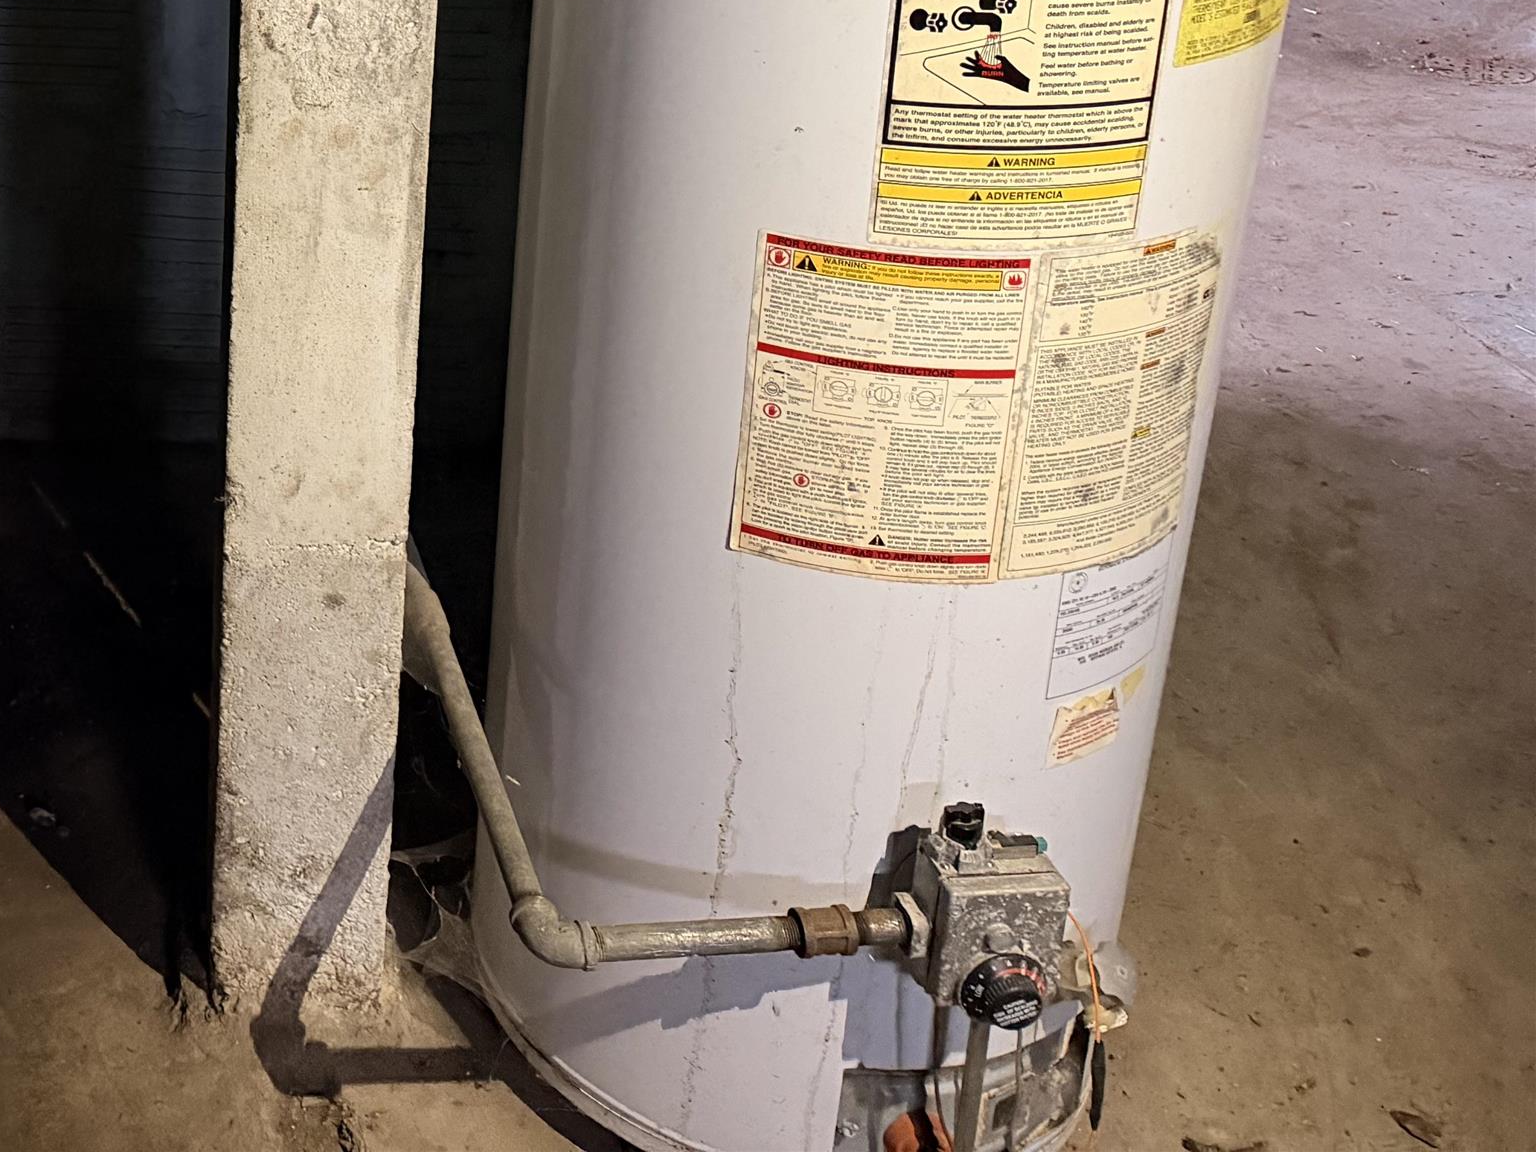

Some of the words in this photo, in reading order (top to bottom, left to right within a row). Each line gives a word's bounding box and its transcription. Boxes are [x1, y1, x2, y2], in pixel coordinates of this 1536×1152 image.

[1003, 158, 1056, 167] WARNING
[986, 191, 1063, 200] ADVERTENCIA
[778, 237, 799, 247] FOR
[805, 241, 833, 254] YOUR
[838, 247, 881, 259] SAFETY
[886, 253, 916, 264] READ
[920, 256, 966, 267] BEFORE
[969, 259, 1020, 268] LIGHTING
[823, 257, 870, 270] WARNING:
[819, 357, 869, 371] LIGHTING
[872, 363, 955, 377] INSTRUCTIONS
[779, 534, 790, 543] TO
[793, 536, 823, 548] TURN
[826, 542, 848, 553] OFF
[851, 547, 872, 557] GAS
[877, 550, 891, 559] TO
[894, 552, 954, 563] APPLIANCE
